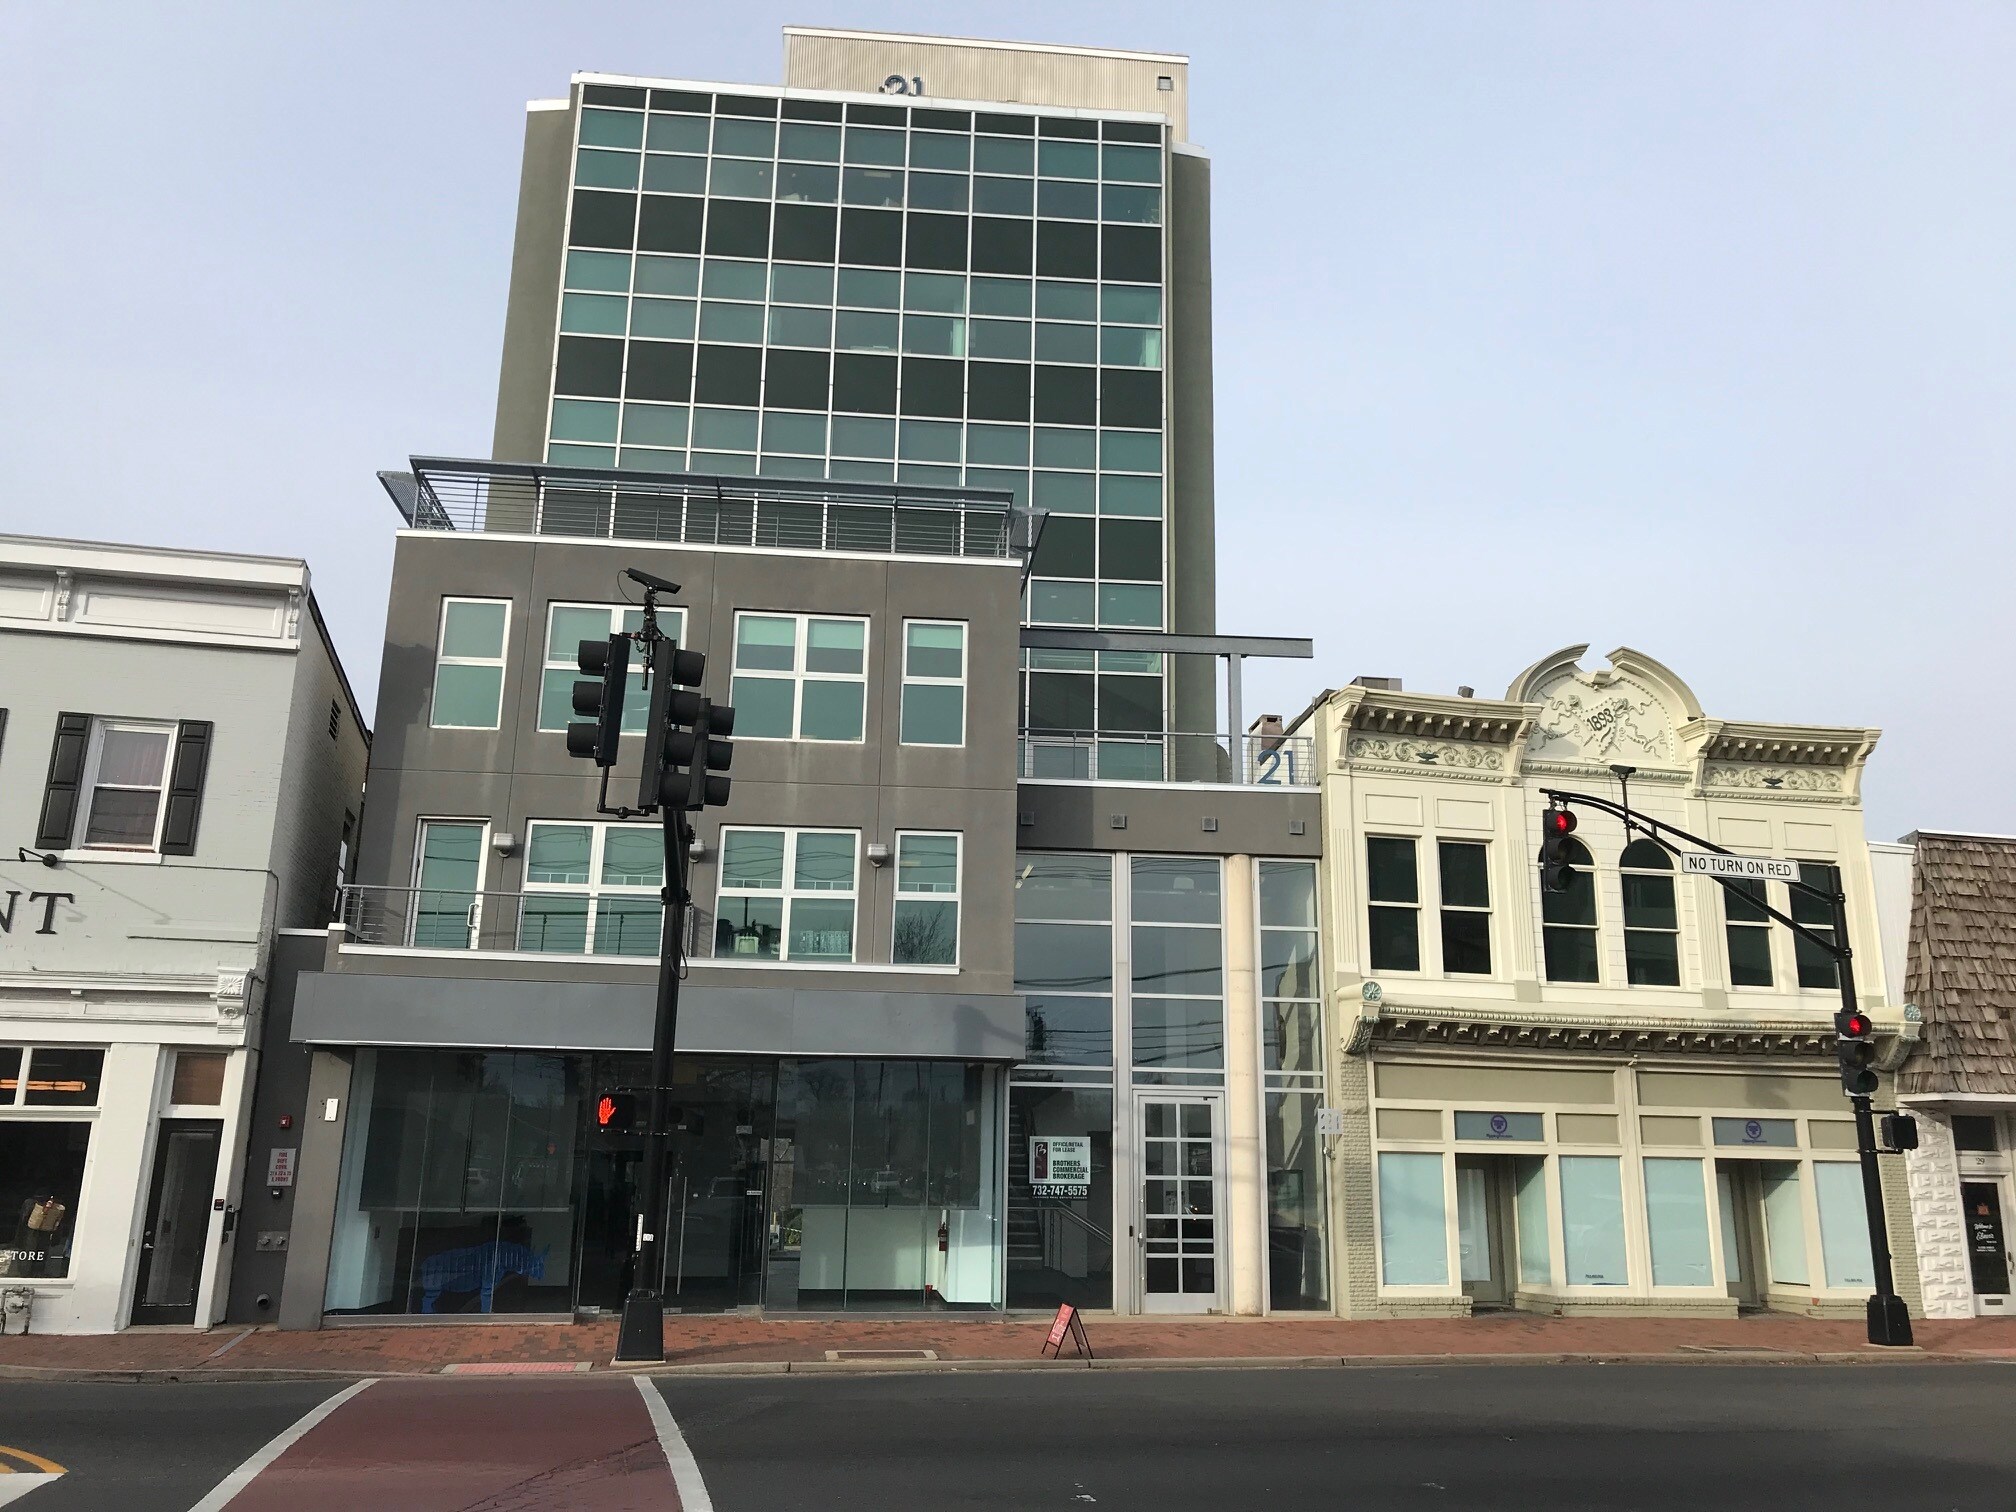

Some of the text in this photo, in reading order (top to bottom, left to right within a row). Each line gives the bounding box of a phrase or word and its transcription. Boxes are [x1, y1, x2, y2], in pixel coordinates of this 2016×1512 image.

[1586, 708, 1614, 731] 1893
[1257, 749, 1295, 785] 21
[1689, 856, 1791, 876] NO TURN ON RED
[1976, 1157, 1985, 1165] 29
[1032, 1185, 1088, 1196] 732-747-5575
[3, 1250, 45, 1261] STORE
